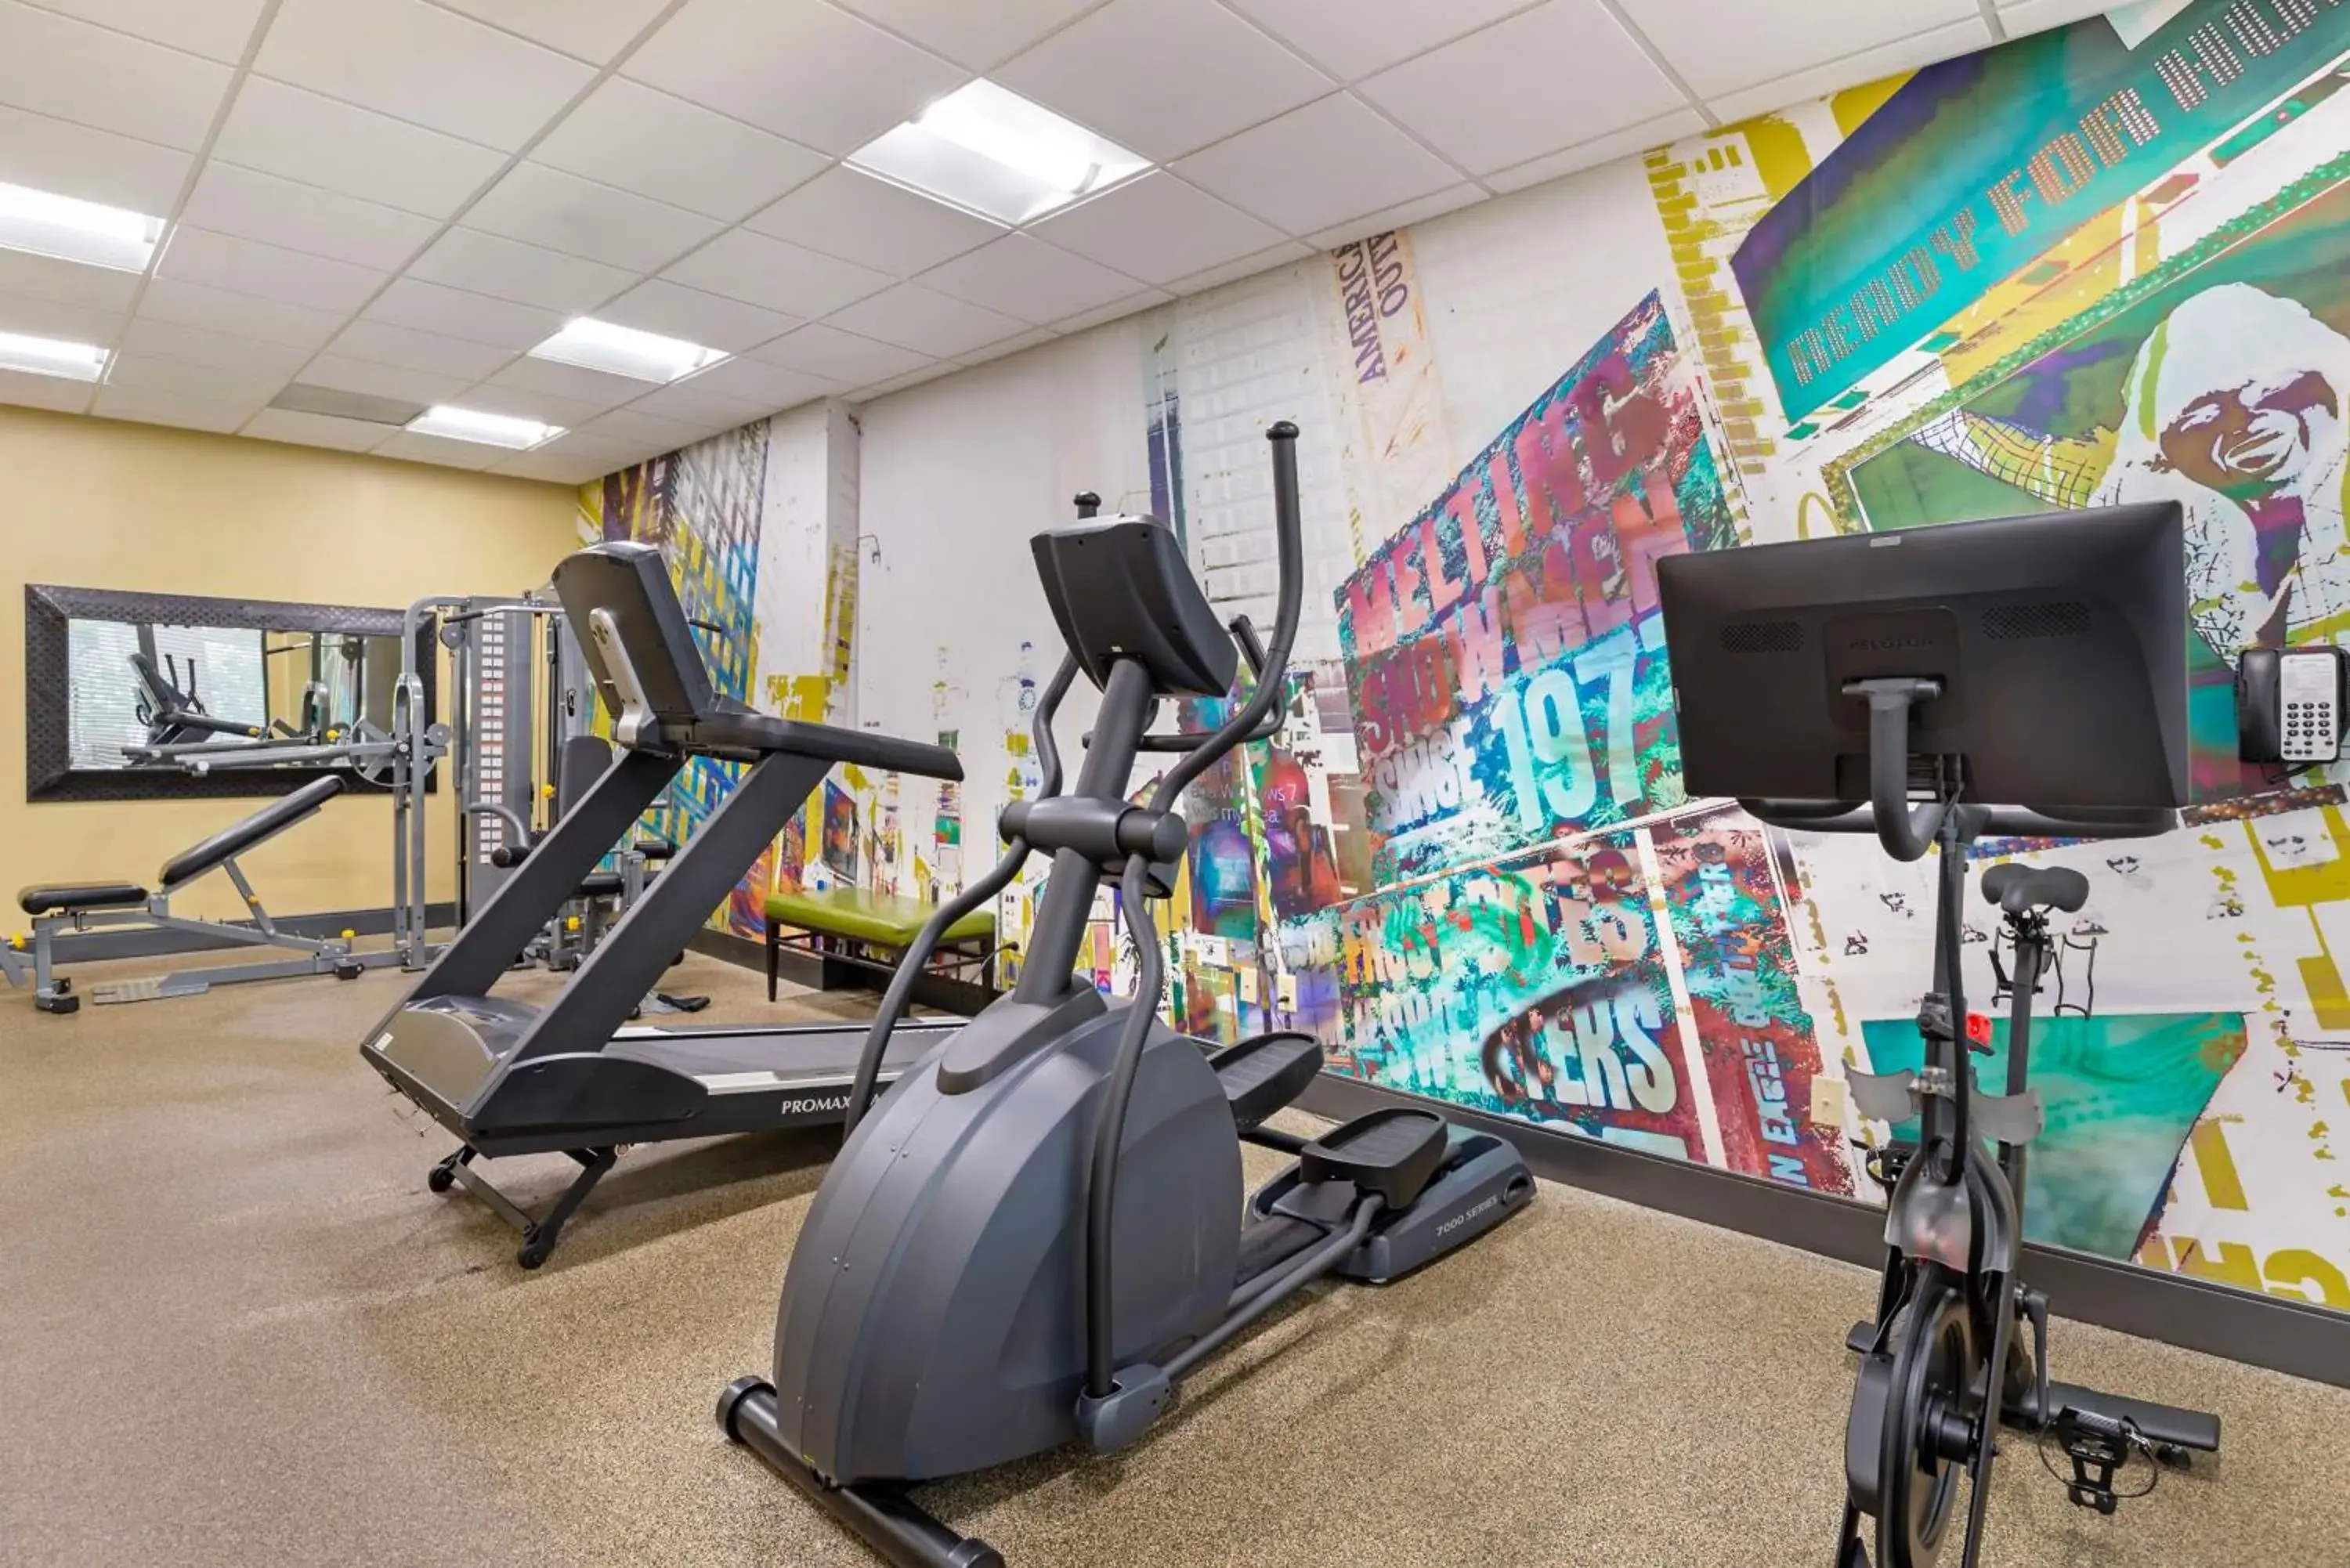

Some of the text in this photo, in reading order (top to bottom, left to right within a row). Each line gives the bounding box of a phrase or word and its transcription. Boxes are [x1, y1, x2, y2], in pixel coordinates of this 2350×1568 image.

[1786, 207, 1980, 387] READY
[1987, 87, 2160, 237] FOR
[1491, 612, 1667, 833] 197
[1436, 1194, 1499, 1238] 7000 SERIES
